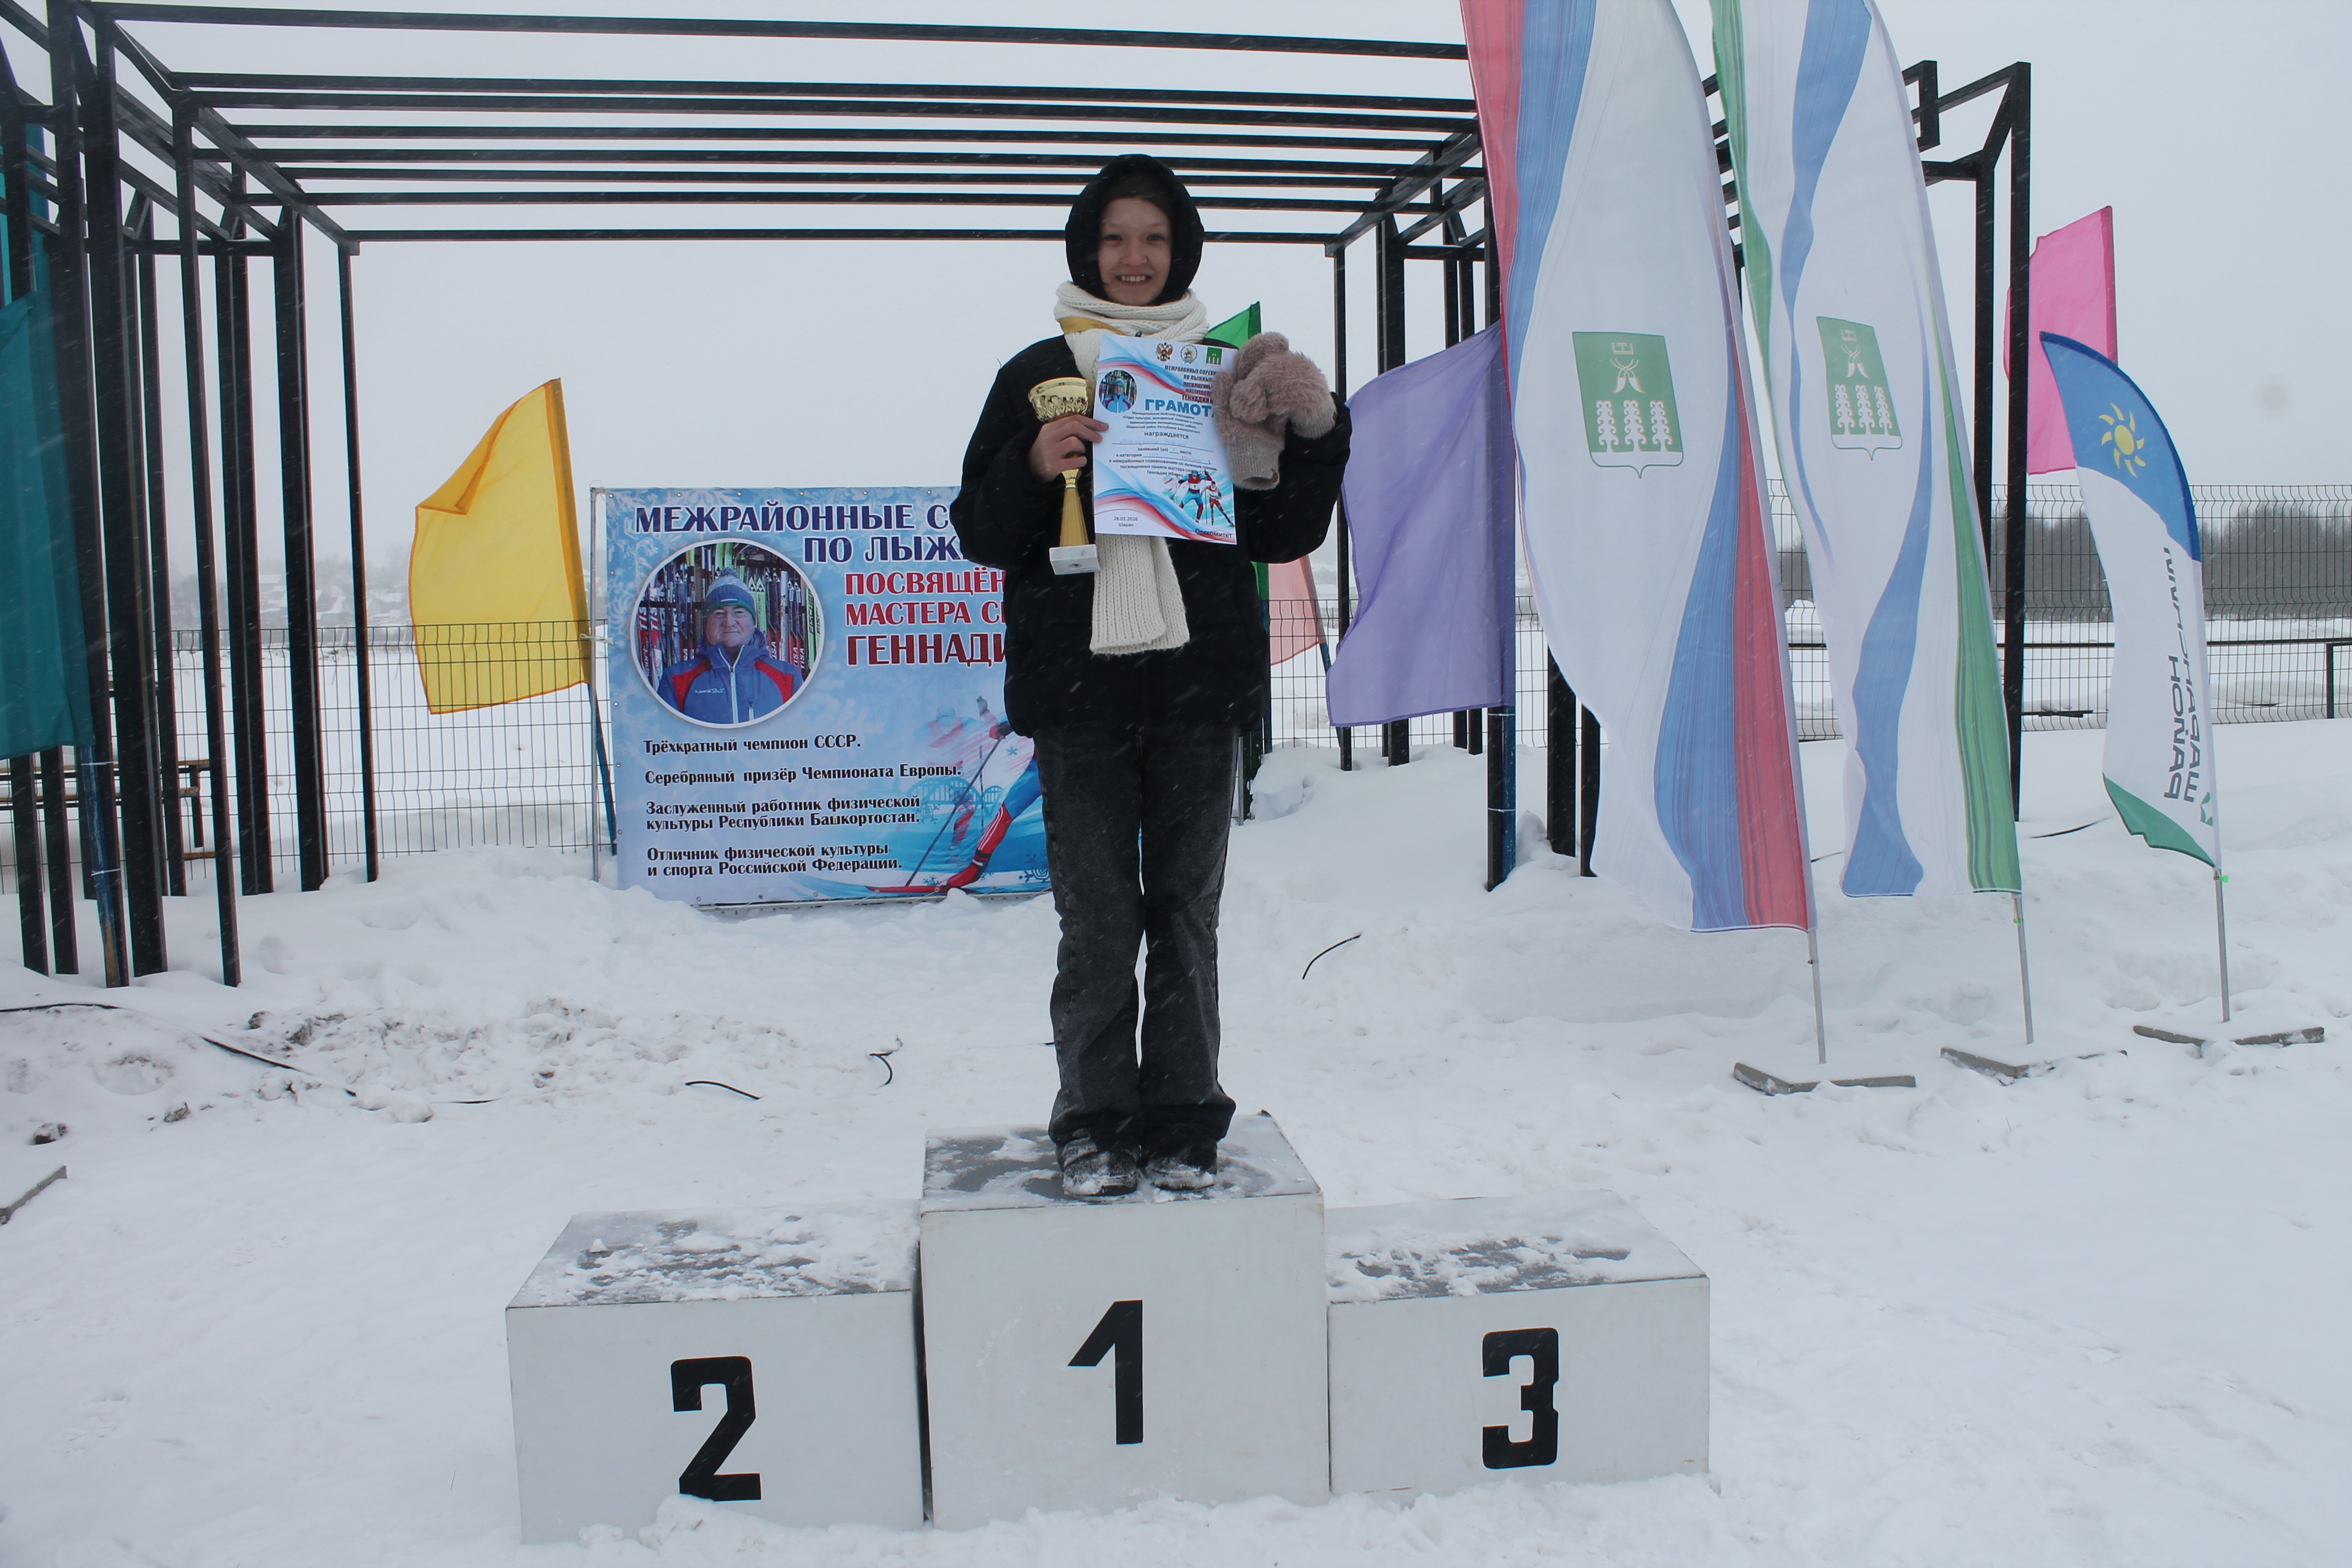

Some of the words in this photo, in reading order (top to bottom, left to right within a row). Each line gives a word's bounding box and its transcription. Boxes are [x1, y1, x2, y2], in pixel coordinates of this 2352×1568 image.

[1165, 365, 1199, 373] МЕЖРАЙОННЫЕ
[1183, 395, 1209, 403] ГЕННАДИЯ
[1145, 432, 1189, 440] награждается
[635, 500, 916, 533] МЕЖРАЙОННЫЕ
[927, 504, 951, 530] С
[1195, 528, 1233, 539] Оргкомитет
[804, 536, 852, 563] ПО
[864, 535, 967, 562] ЛЫЖ
[846, 601, 971, 626] МАСТЕРА
[643, 738, 737, 755] Трёхкратный
[743, 738, 808, 751] чемпион
[814, 734, 861, 748] СССР.
[645, 770, 735, 786] Серебряный
[743, 767, 797, 784] призёр
[802, 766, 894, 780] Чемпионата
[900, 764, 961, 778] Европы.
[646, 801, 746, 816] Заслуженный
[752, 799, 822, 815] работник
[827, 795, 920, 812] физической
[646, 818, 713, 832] культуры
[718, 815, 804, 830] Республики
[810, 812, 920, 826] Башкортостан.
[647, 847, 719, 861] Отличник
[724, 845, 815, 862] физической
[821, 843, 889, 858] культуры
[647, 866, 657, 876] и
[663, 865, 714, 878] спорта
[718, 859, 807, 875] Российской
[812, 858, 902, 873] Федерации.
[1068, 1299, 1143, 1445] 1
[1482, 1327, 1559, 1469] 3
[670, 1355, 761, 1501] 2
